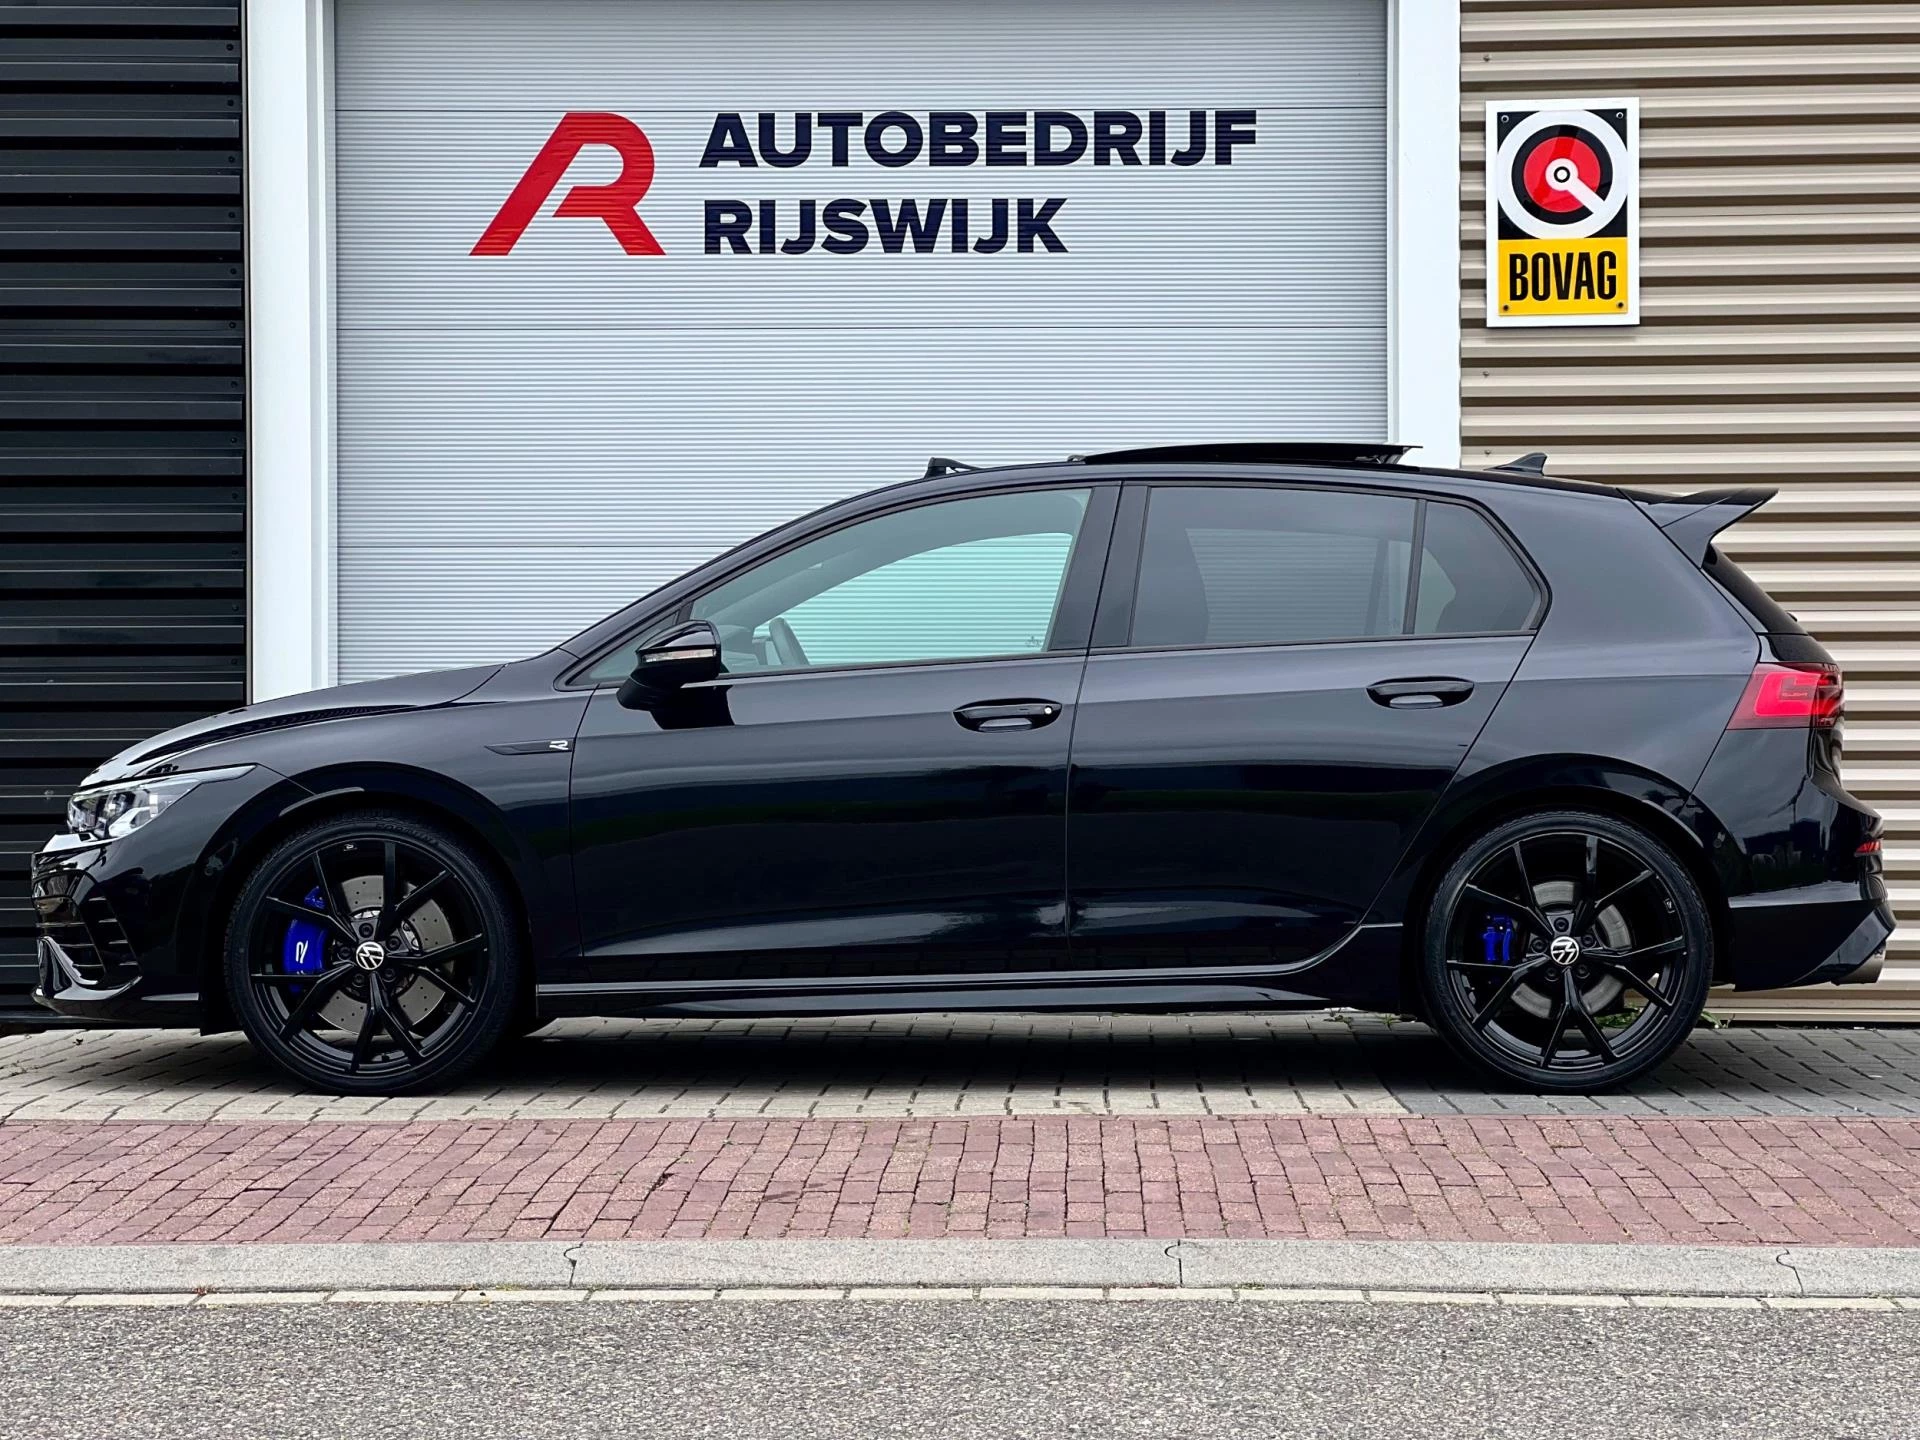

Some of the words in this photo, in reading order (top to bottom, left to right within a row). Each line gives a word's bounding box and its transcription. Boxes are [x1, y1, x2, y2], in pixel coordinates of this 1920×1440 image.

[699, 110, 1257, 168] AUTOBEDRIJF
[704, 198, 1068, 256] RIJSWIJK
[1509, 251, 1617, 302] BOVAG
